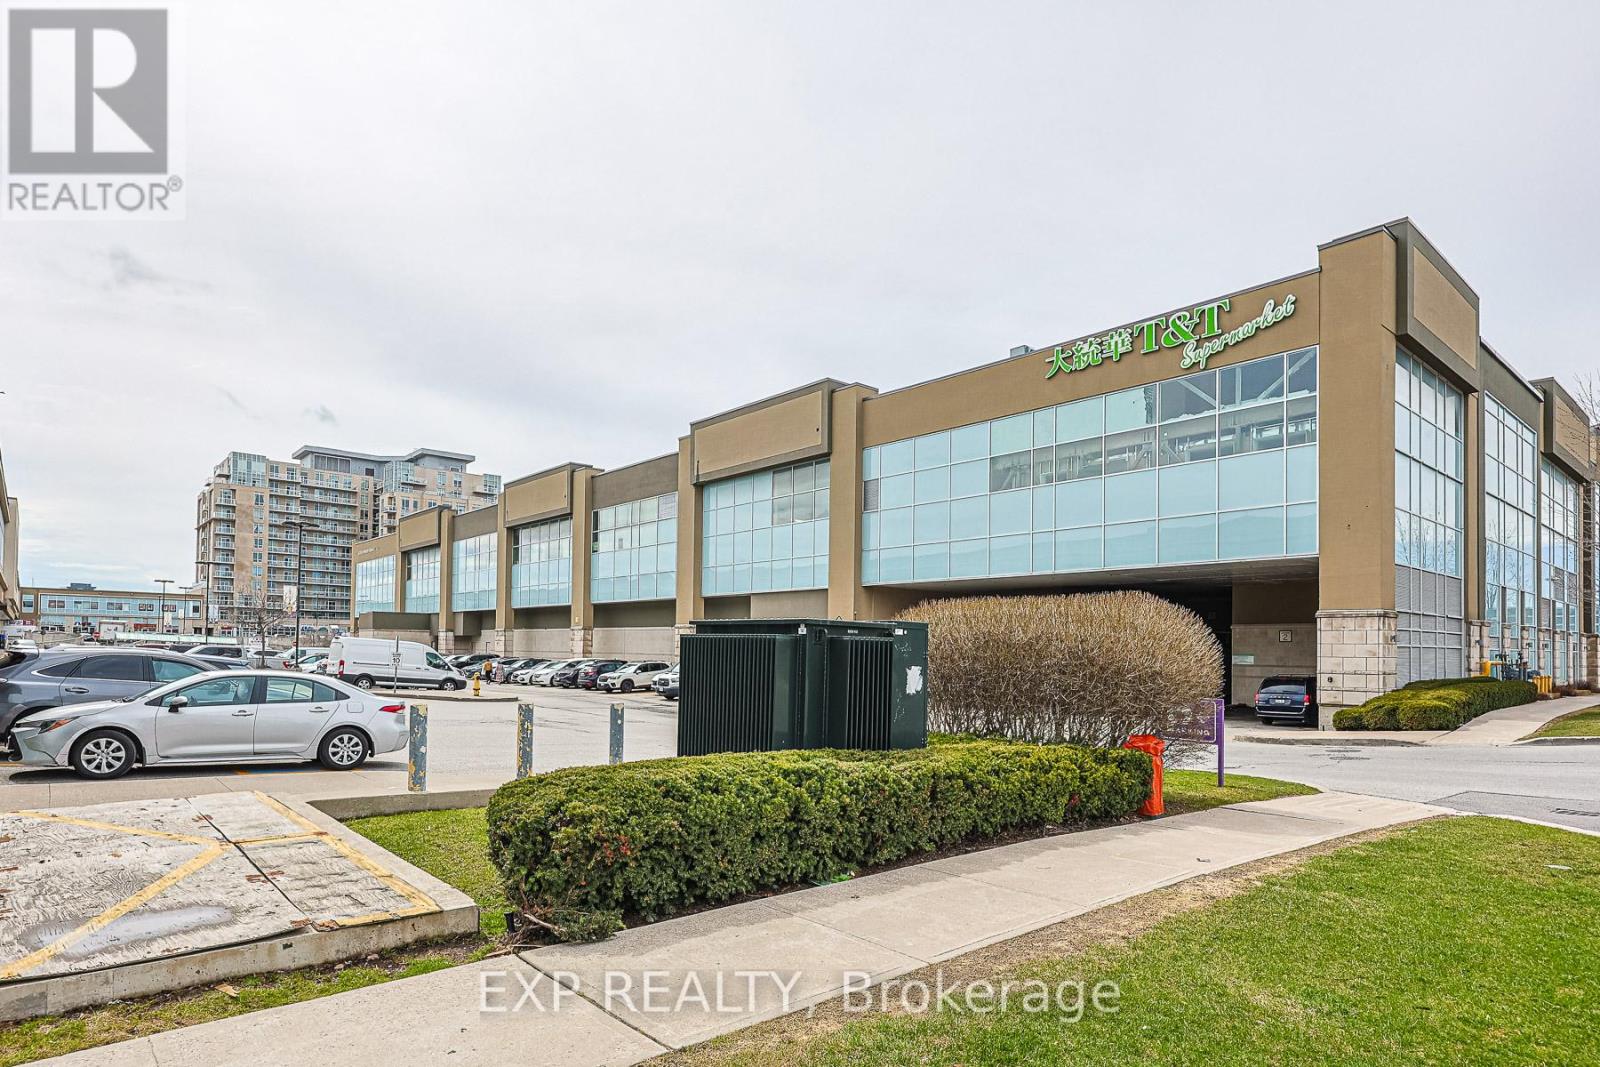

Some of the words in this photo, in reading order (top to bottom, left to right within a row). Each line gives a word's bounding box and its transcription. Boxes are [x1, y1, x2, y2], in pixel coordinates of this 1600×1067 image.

[1045, 327, 1134, 379] 大統華
[1134, 298, 1230, 354] T&T
[1180, 293, 1297, 370] Supermarket
